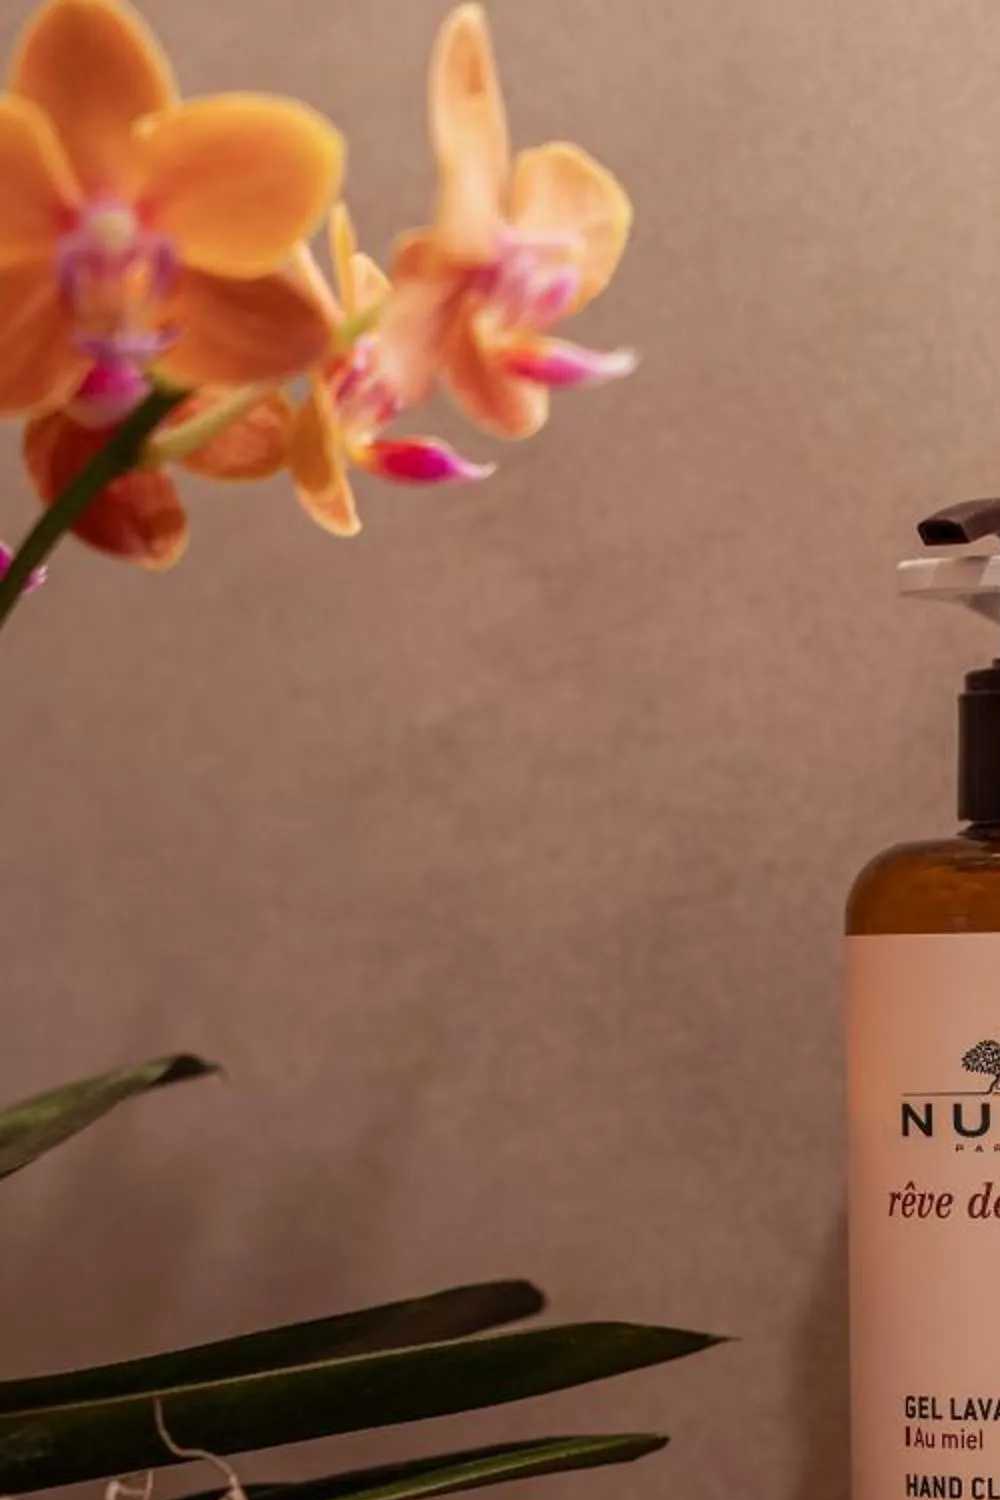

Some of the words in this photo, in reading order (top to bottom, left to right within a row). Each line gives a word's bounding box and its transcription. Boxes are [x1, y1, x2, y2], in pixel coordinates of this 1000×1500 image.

[887, 1180, 954, 1219] rêve
[904, 1395, 943, 1420] GEL
[913, 1427, 935, 1449] Au
[941, 1428, 984, 1450] miel
[905, 1473, 963, 1499] HAND
